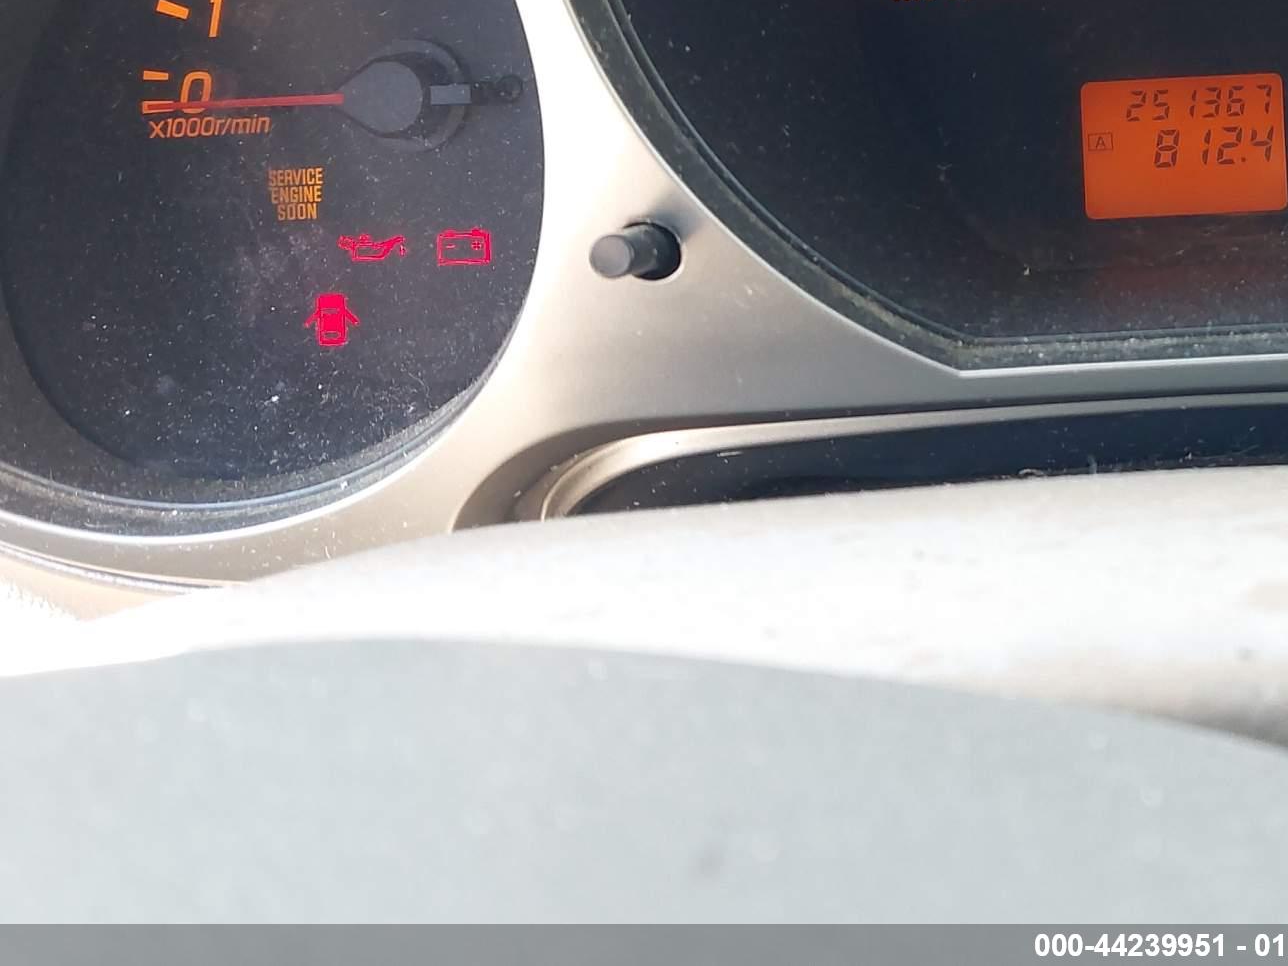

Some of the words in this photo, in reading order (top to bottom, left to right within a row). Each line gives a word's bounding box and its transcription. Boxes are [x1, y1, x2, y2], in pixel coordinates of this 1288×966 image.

[180, 70, 213, 114] 0
[1126, 84, 1272, 122] 251367
[1154, 125, 1274, 168] 812.4
[268, 167, 324, 186] SERVICE
[270, 185, 323, 204] ENGINE
[277, 203, 318, 221] SOON
